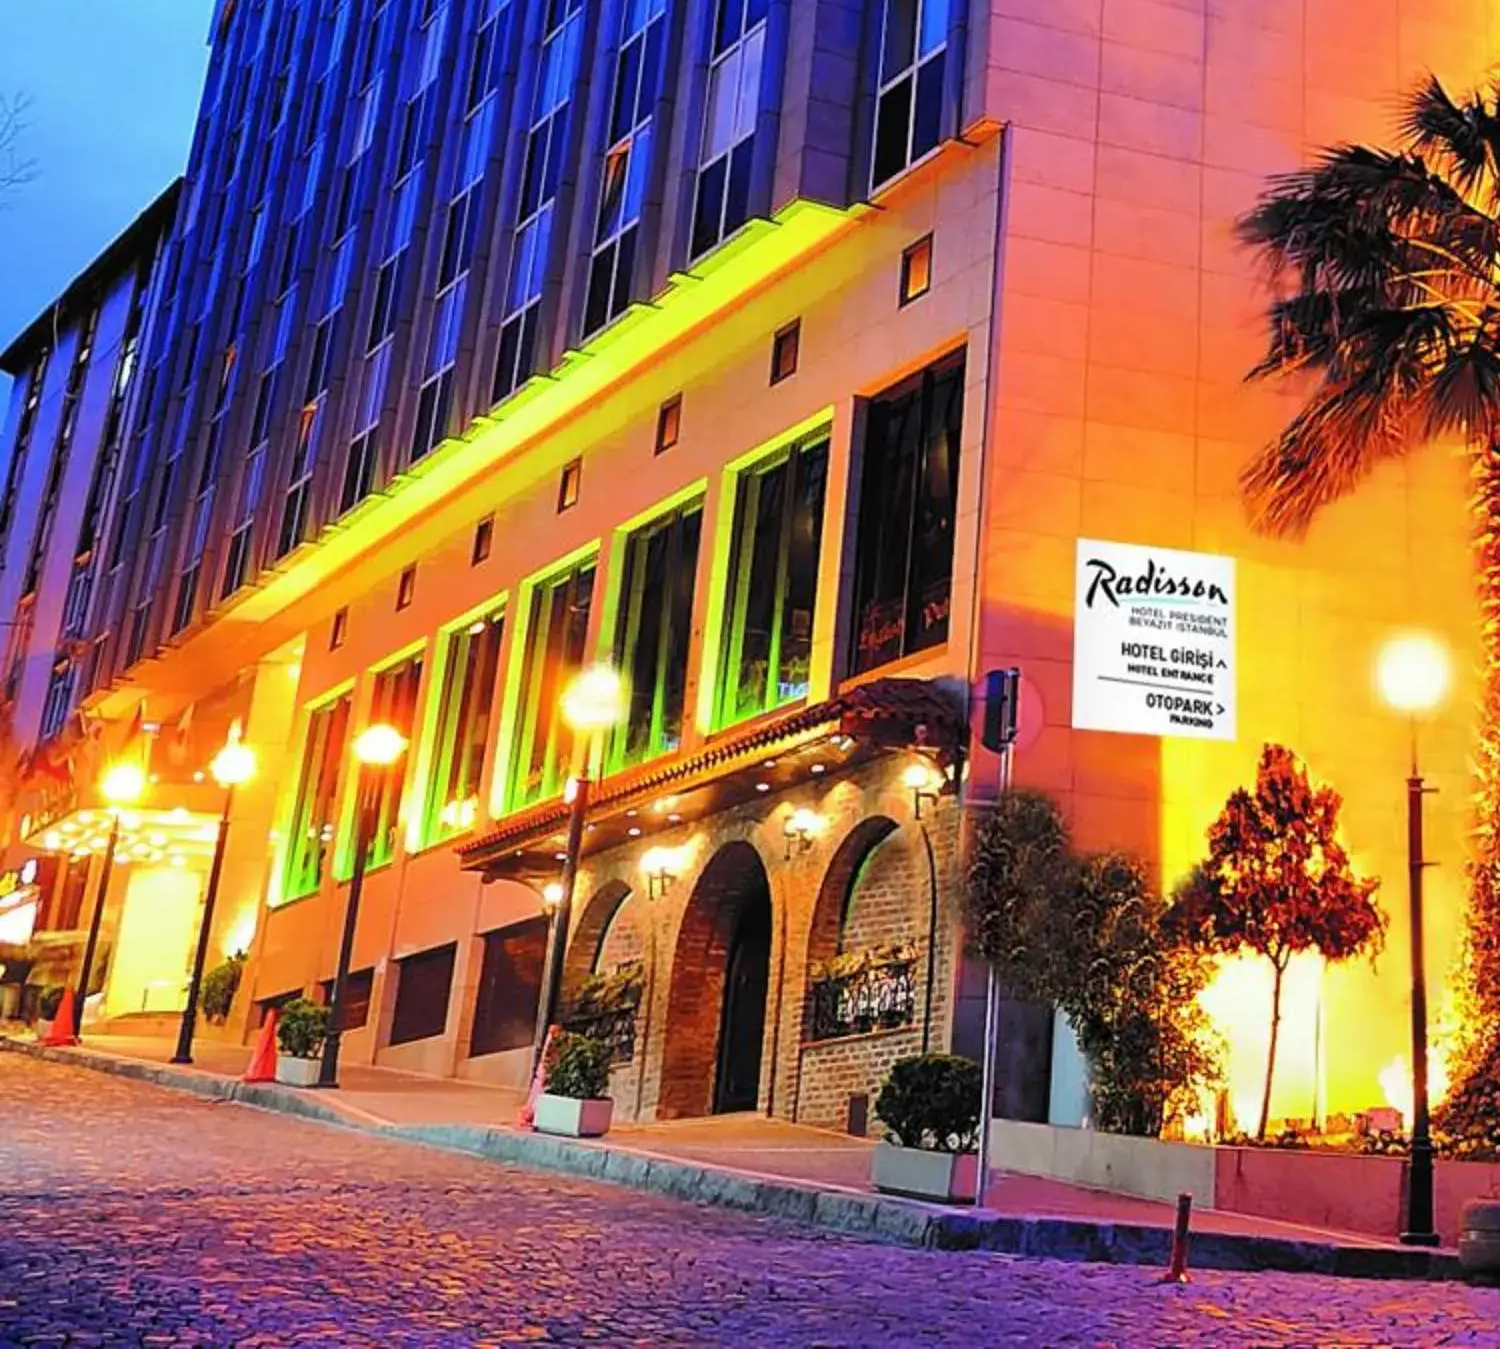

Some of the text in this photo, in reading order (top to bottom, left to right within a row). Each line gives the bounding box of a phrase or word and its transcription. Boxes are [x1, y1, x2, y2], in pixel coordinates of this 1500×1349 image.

[1086, 558, 1228, 609] Radisson
[1131, 606, 1228, 626] HOTEL PRESIDENT
[1121, 641, 1214, 670] HOTEL GİRİŞİ
[1127, 663, 1214, 684] HOTEL ENTRANCE
[1146, 692, 1214, 716] OTOPARK
[1169, 714, 1214, 729] PARKING
